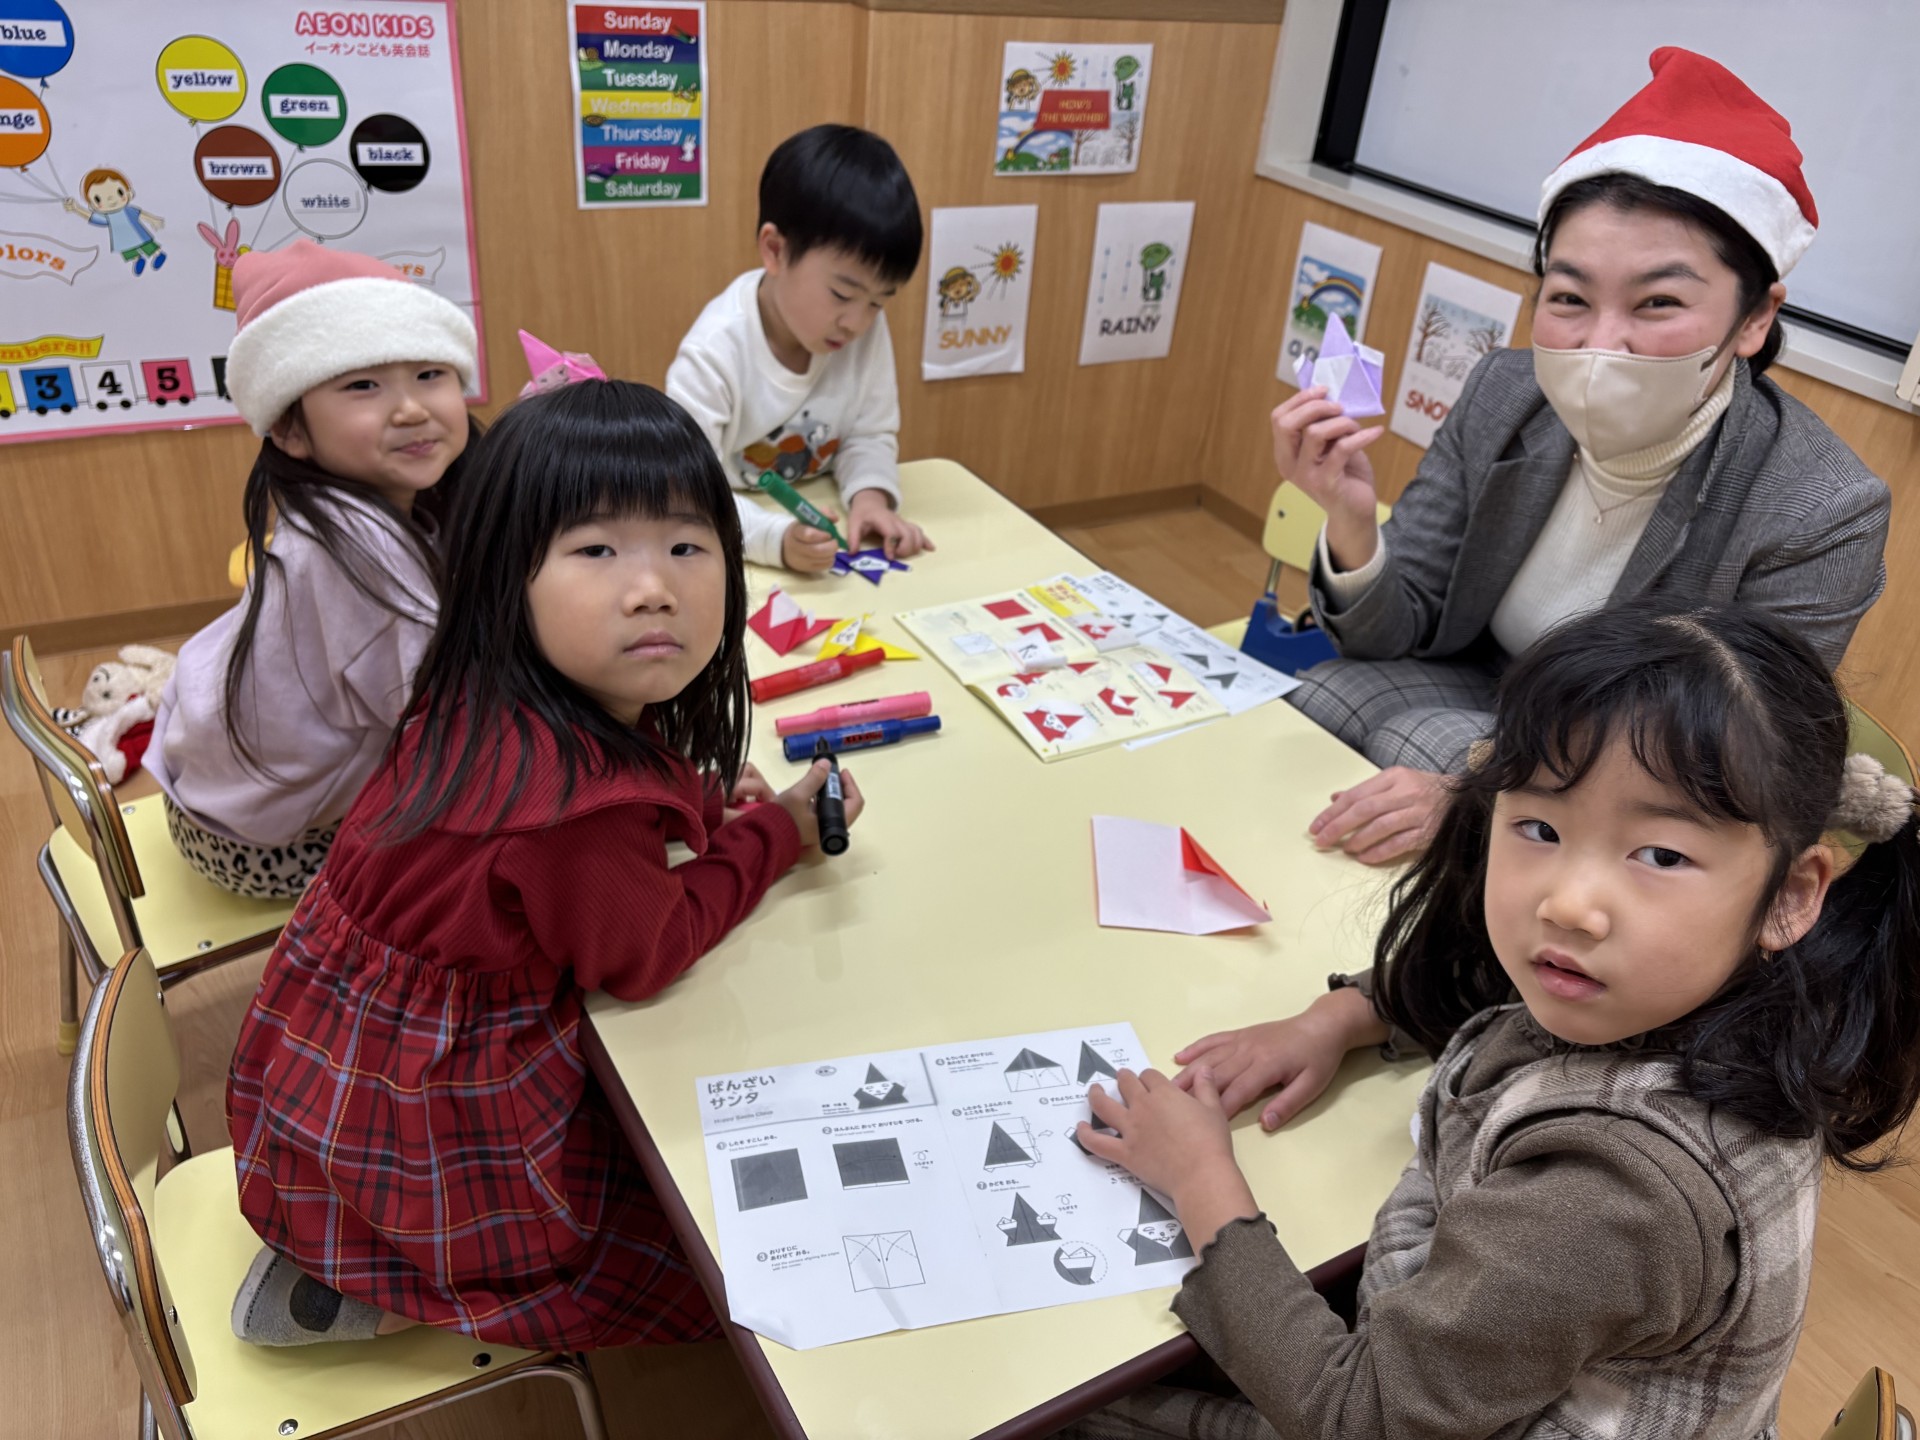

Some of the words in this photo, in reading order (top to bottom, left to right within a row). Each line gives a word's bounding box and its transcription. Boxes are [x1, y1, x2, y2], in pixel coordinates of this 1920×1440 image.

[295, 12, 370, 37] AEON
[373, 14, 435, 39] KIDS
[604, 10, 672, 33] Sunday
[0, 25, 47, 41] blue
[305, 41, 430, 57] イーオンこども英会話
[603, 40, 674, 62] Monday
[171, 72, 234, 89] yellow
[602, 68, 678, 90] Tuesday
[280, 98, 330, 114] green
[590, 98, 692, 116] Wednesday
[601, 124, 682, 144] Thursday
[368, 147, 414, 162] black
[615, 152, 670, 172] Friday
[210, 161, 268, 176] brown
[604, 180, 682, 198] Saturday
[301, 195, 350, 209] white
[1099, 315, 1161, 336] RAINY
[939, 324, 1012, 349] SUNNY
[35, 374, 62, 400] 3
[98, 370, 123, 395] 4
[157, 366, 180, 392] 5
[707, 1075, 776, 1094] ばんざい
[709, 1091, 759, 1110] サンタ
